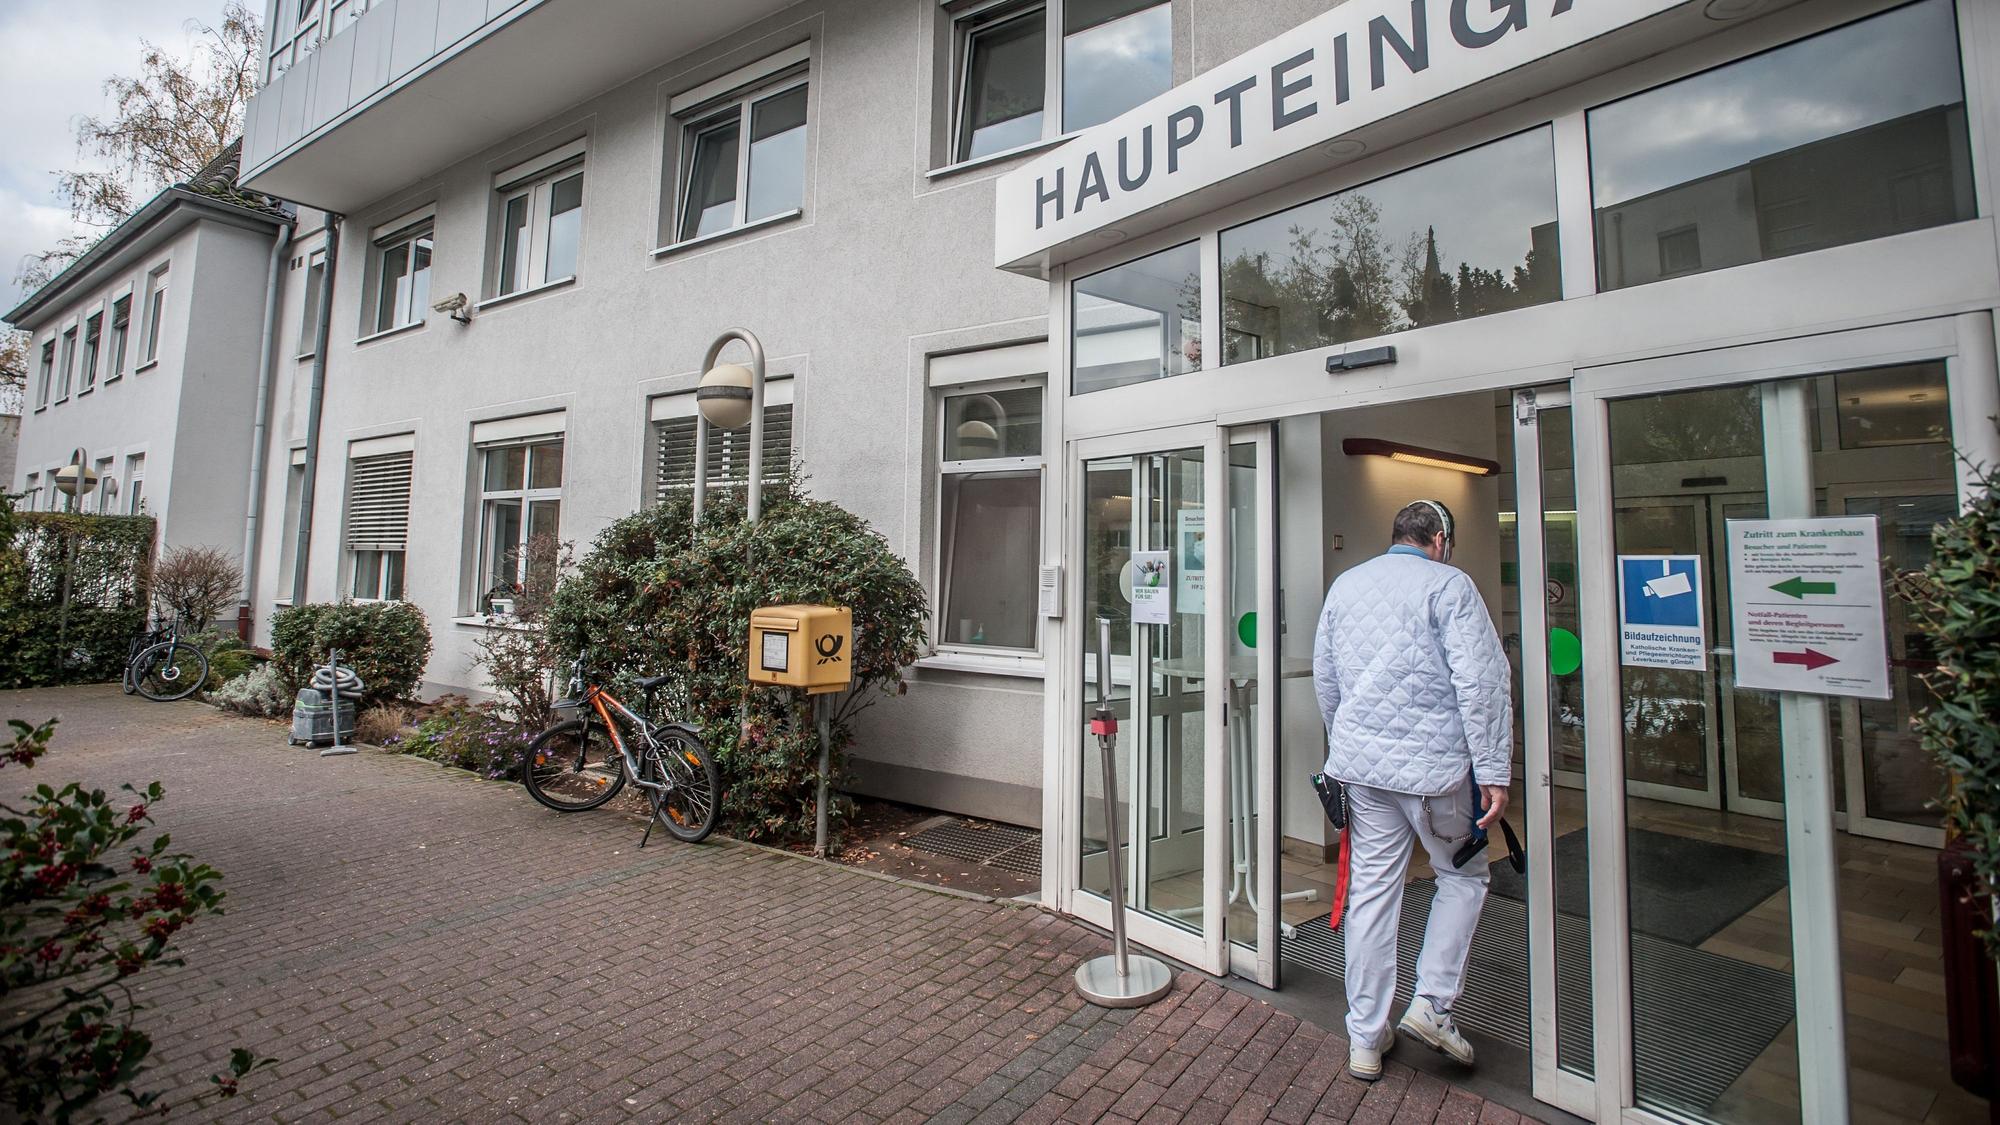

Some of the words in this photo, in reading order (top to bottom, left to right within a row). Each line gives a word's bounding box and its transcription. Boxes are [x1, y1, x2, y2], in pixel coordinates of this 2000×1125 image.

[1034, 0, 1574, 230] HAUPTEING
[1743, 531, 1773, 539] Zutritt
[1799, 529, 1865, 538] Krankenhaus
[1747, 611, 1808, 619] Notfall-Patienten
[1785, 620, 1845, 628] Begleitpersonen
[1624, 631, 1701, 646] Bildaufzeichnung
[1630, 644, 1667, 652] Katholische
[1638, 650, 1701, 660] Pflegeeinrichtungen
[1632, 656, 1668, 664] Leverkusen
